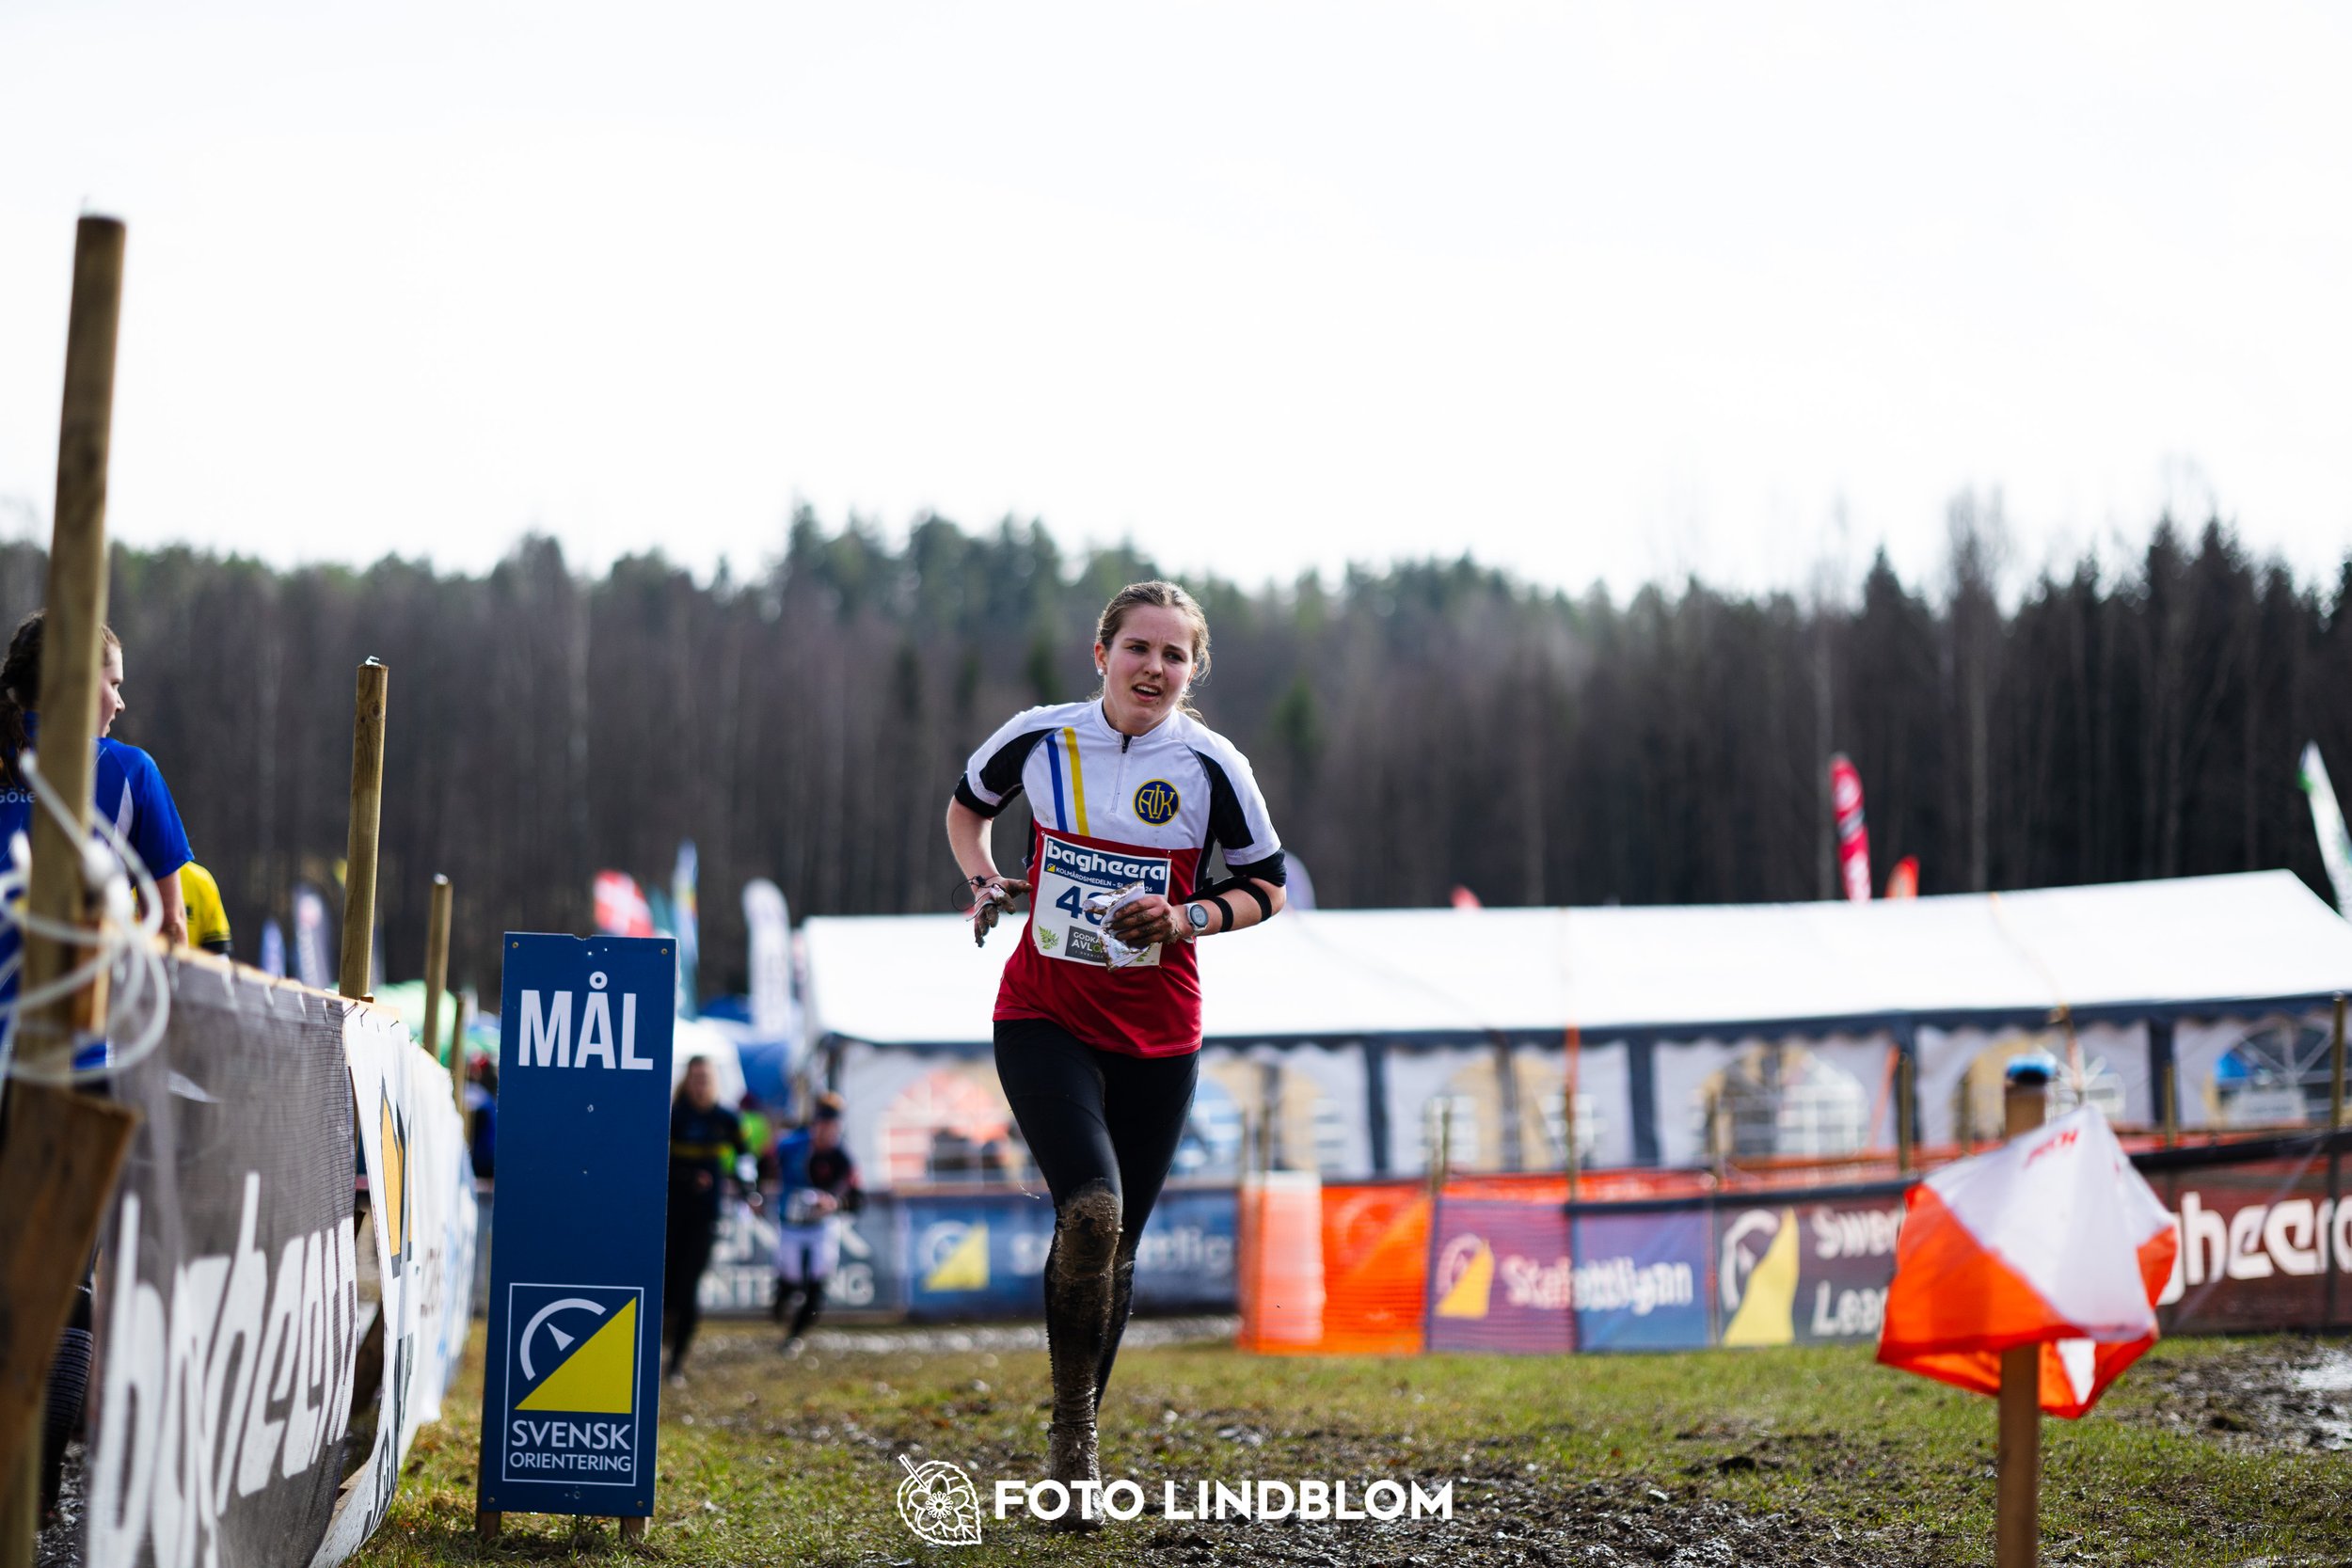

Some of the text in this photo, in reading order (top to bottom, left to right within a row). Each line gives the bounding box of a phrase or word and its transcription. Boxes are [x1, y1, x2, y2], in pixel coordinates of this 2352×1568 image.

[1046, 840, 1166, 881] bagheera
[1056, 866, 1112, 886] KOLMÅRDSMEDELN
[518, 971, 654, 1070] MÅL
[511, 1418, 631, 1451] SVENSK
[509, 1451, 631, 1473] ORIENTERING
